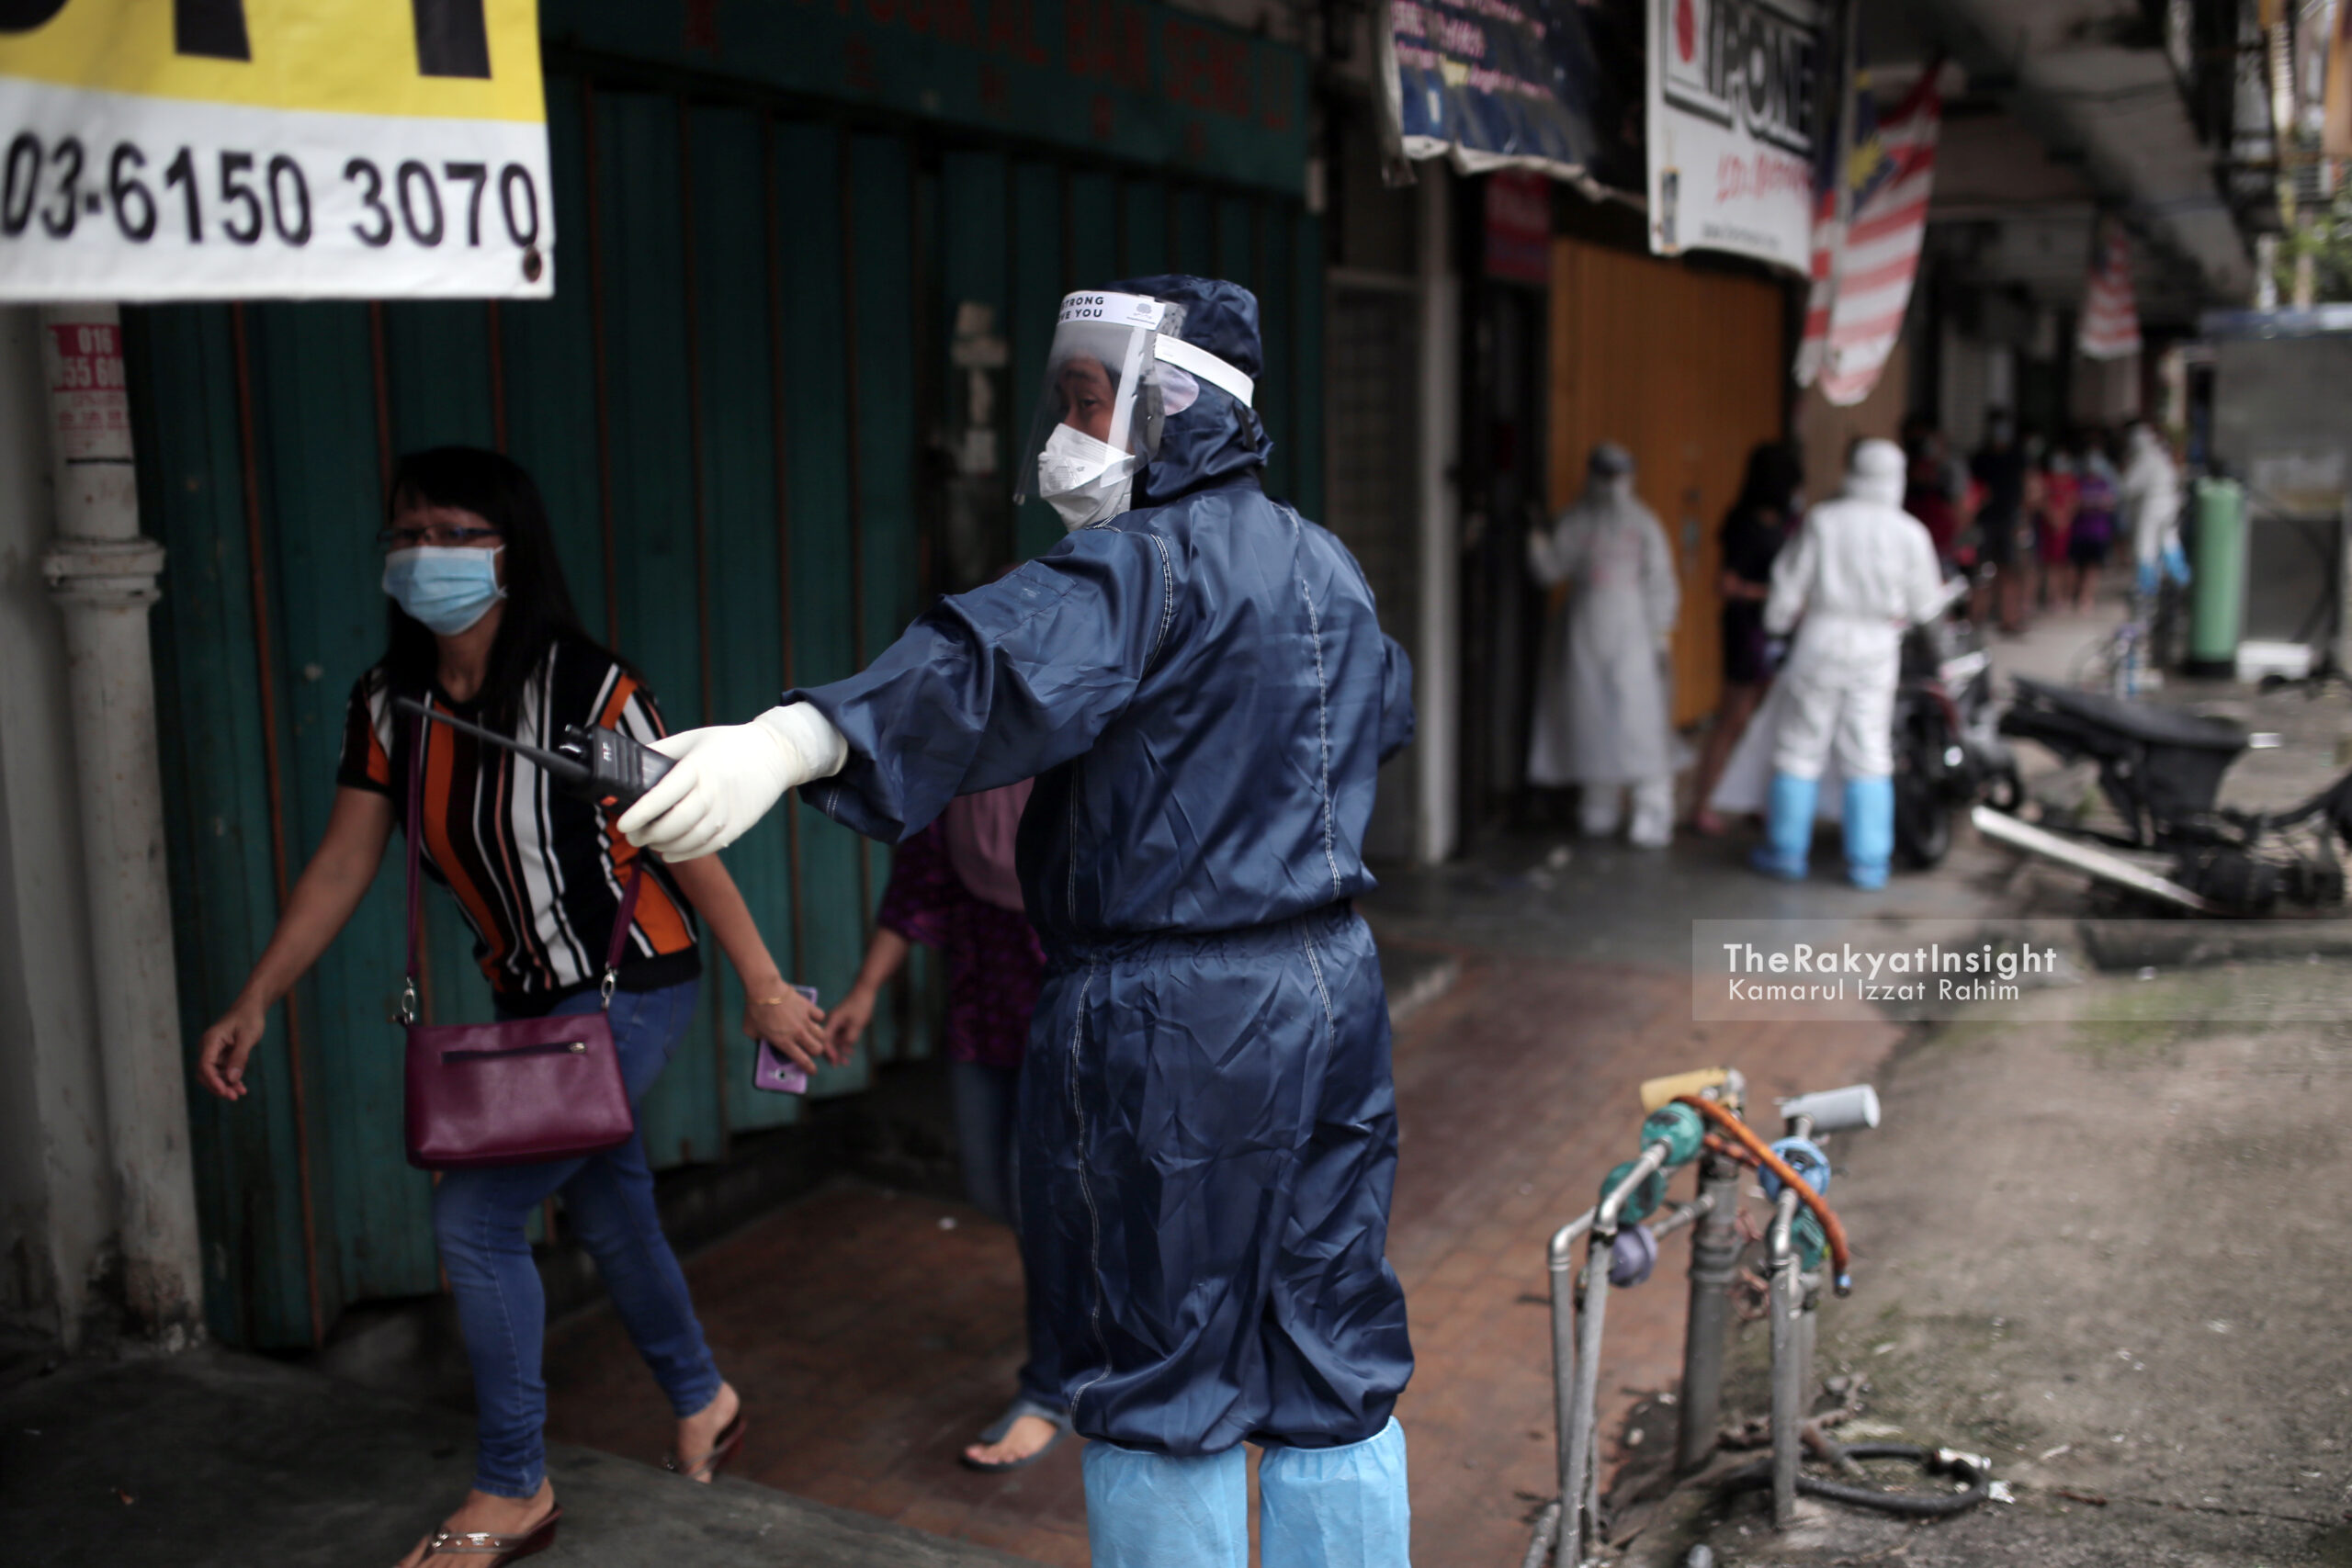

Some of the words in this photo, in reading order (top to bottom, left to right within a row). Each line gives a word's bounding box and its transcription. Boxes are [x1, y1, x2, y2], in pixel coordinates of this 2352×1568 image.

[1, 131, 312, 246] 03-6150
[344, 157, 539, 248] 3070
[1075, 308, 1103, 319] YOU
